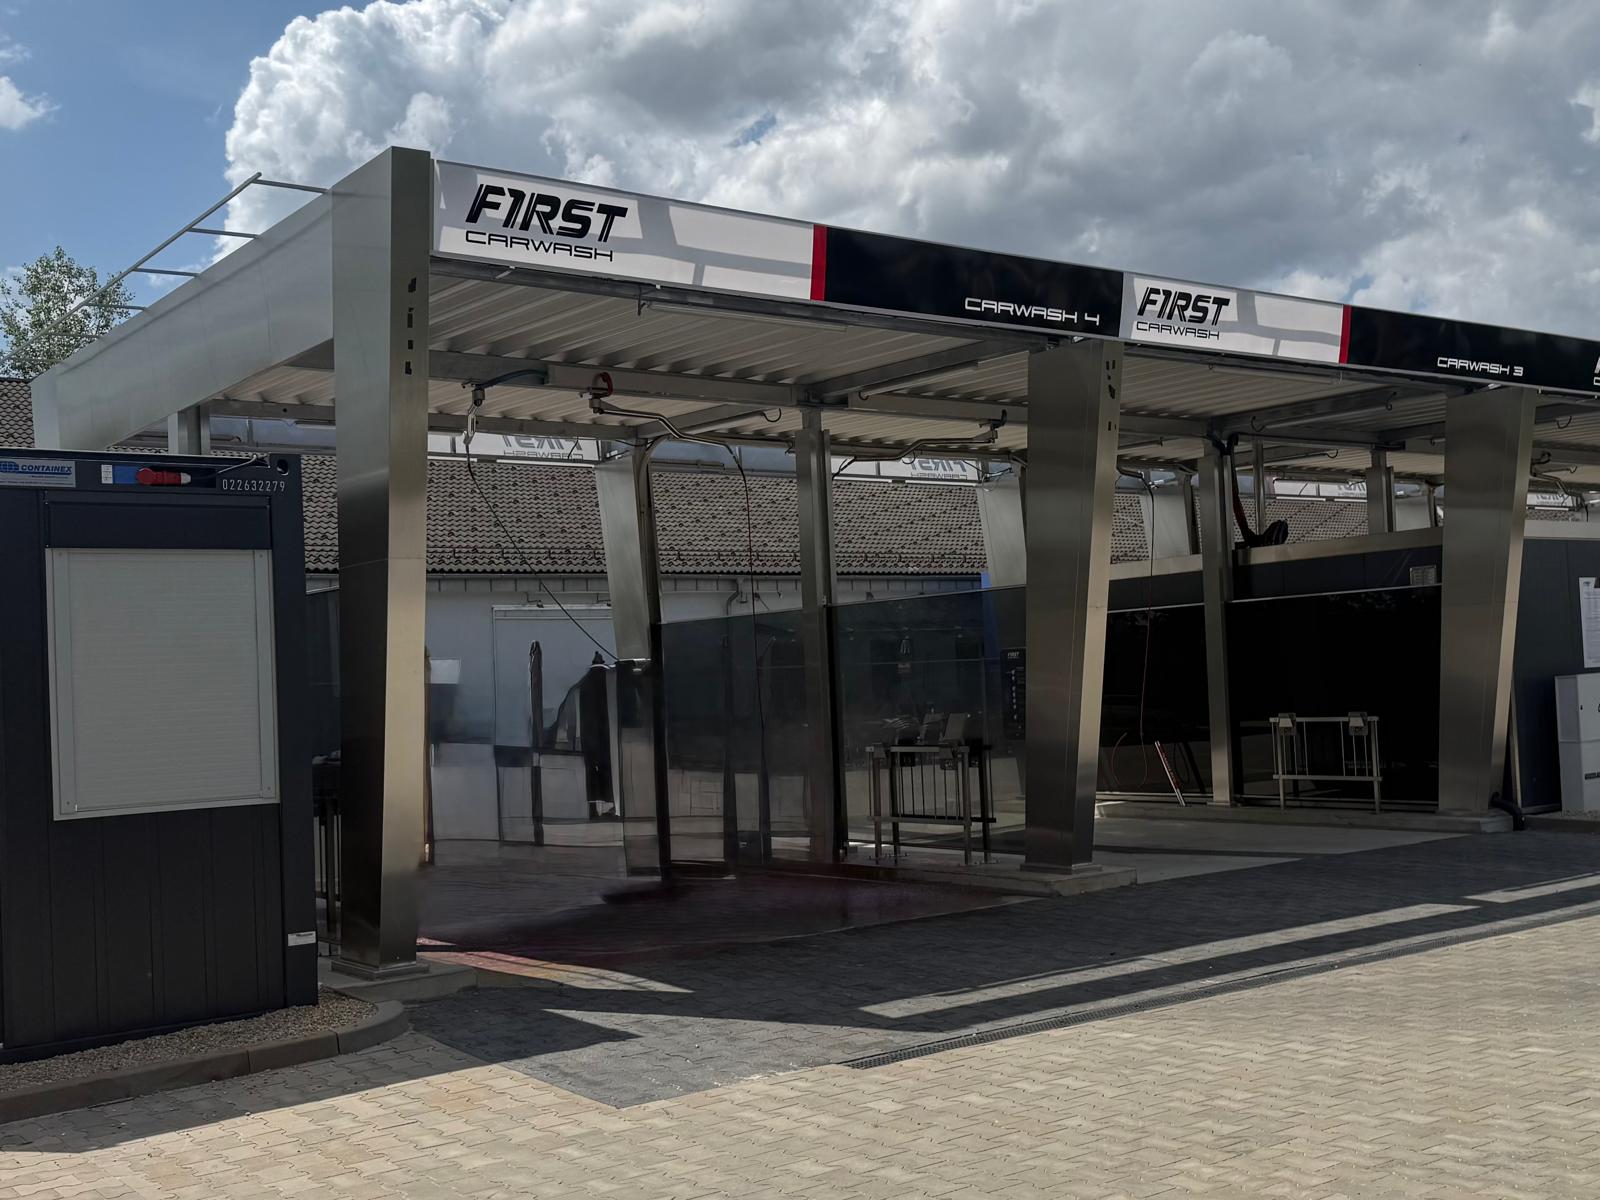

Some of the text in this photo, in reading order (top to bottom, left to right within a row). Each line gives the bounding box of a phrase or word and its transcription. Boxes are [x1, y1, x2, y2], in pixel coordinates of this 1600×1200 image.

[465, 230, 613, 262] CARWASH
[965, 297, 1100, 326] CARWASH 4
[1136, 321, 1220, 340] CARWASH
[1437, 357, 1524, 377] CARWASH 3
[21, 464, 73, 473] CONTAINEX
[222, 479, 285, 492] 022632279
